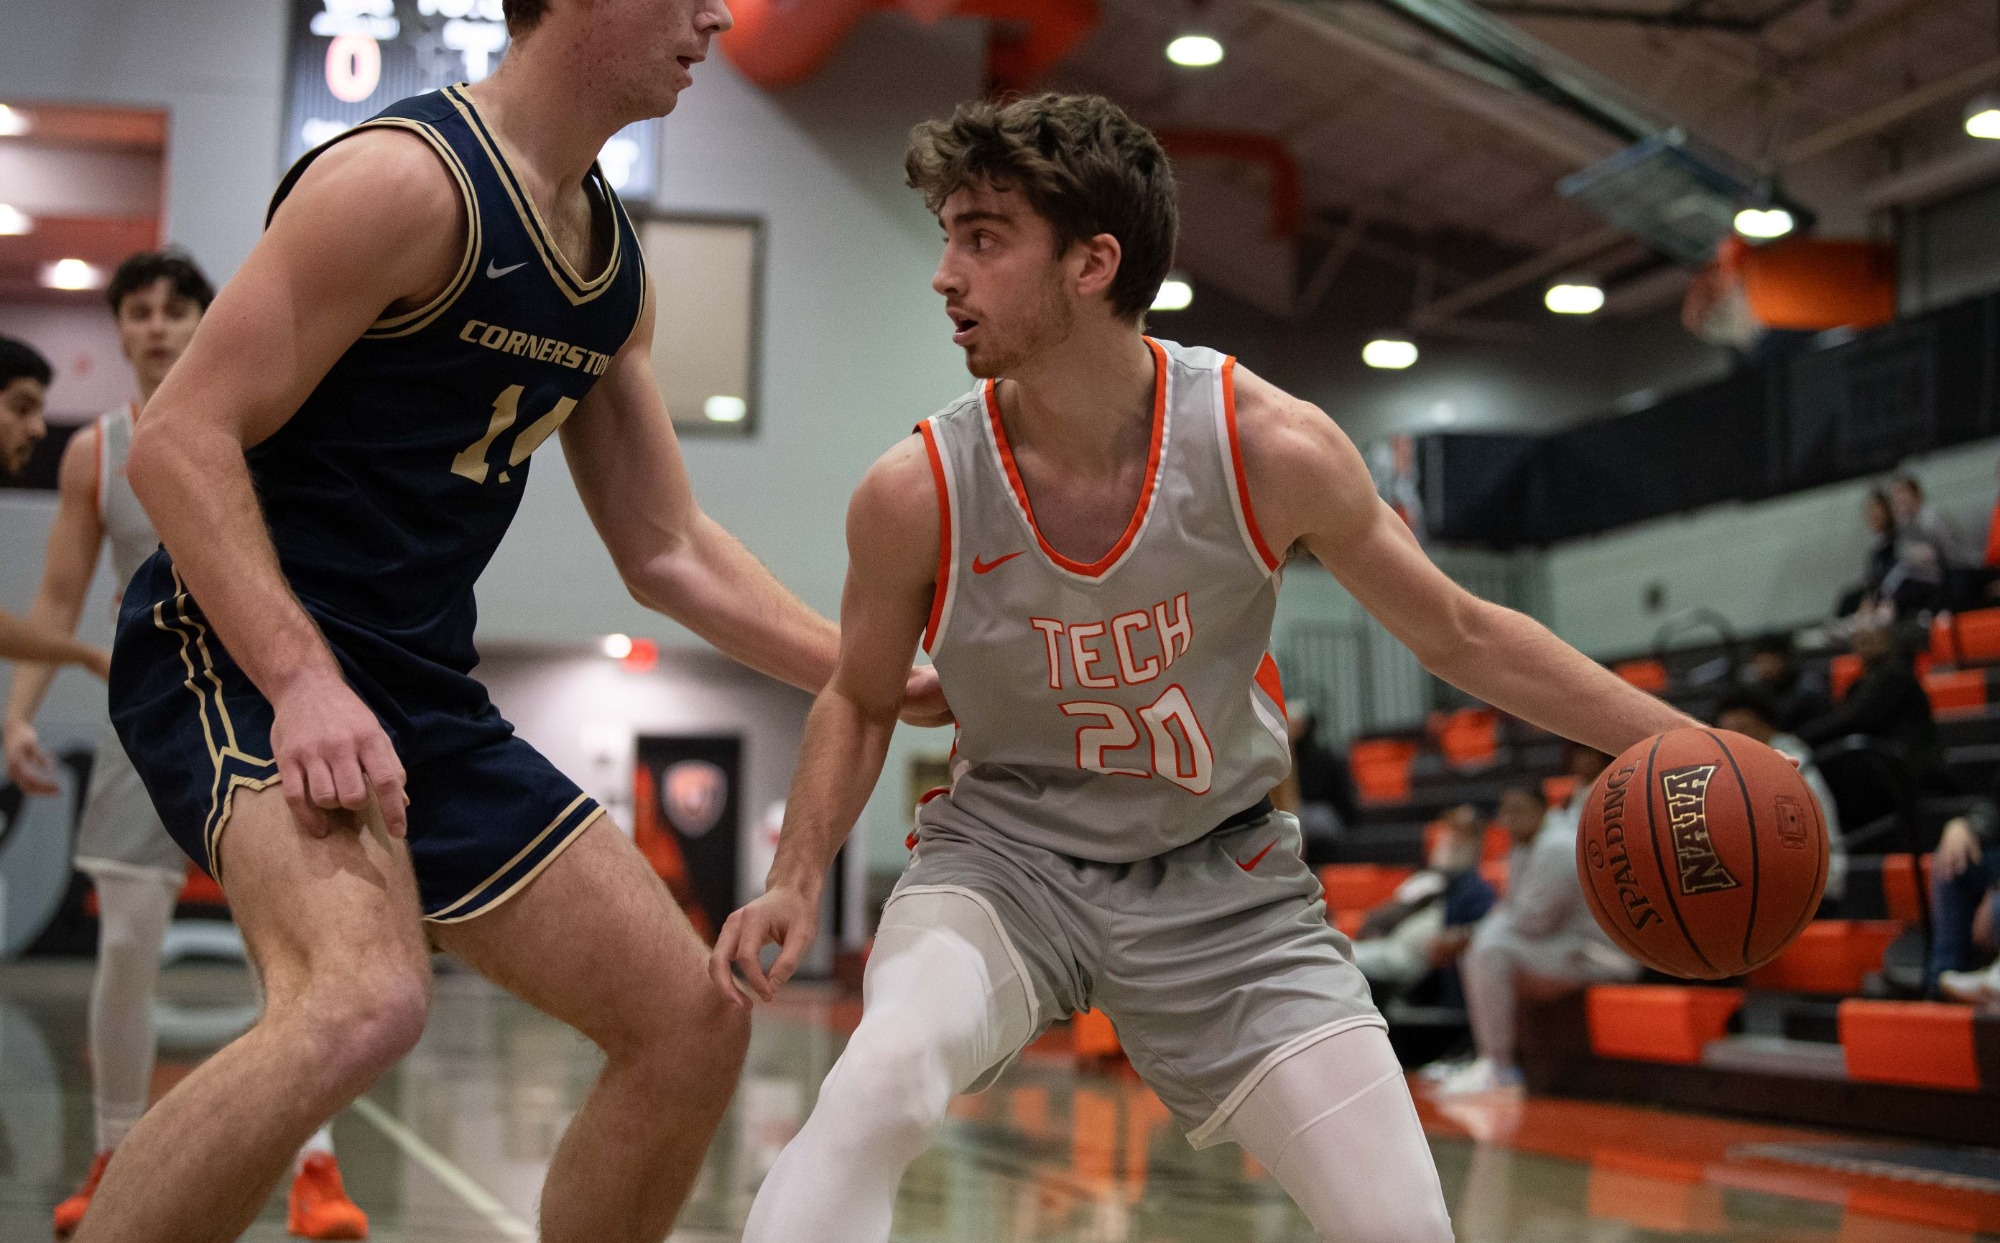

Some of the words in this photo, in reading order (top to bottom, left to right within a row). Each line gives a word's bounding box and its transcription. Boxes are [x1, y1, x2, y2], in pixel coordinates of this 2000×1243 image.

[1030, 591, 1193, 690] TECH
[1058, 684, 1214, 796] 20
[1604, 765, 1663, 931] SPALDING
[1663, 764, 1739, 895] NAIA
